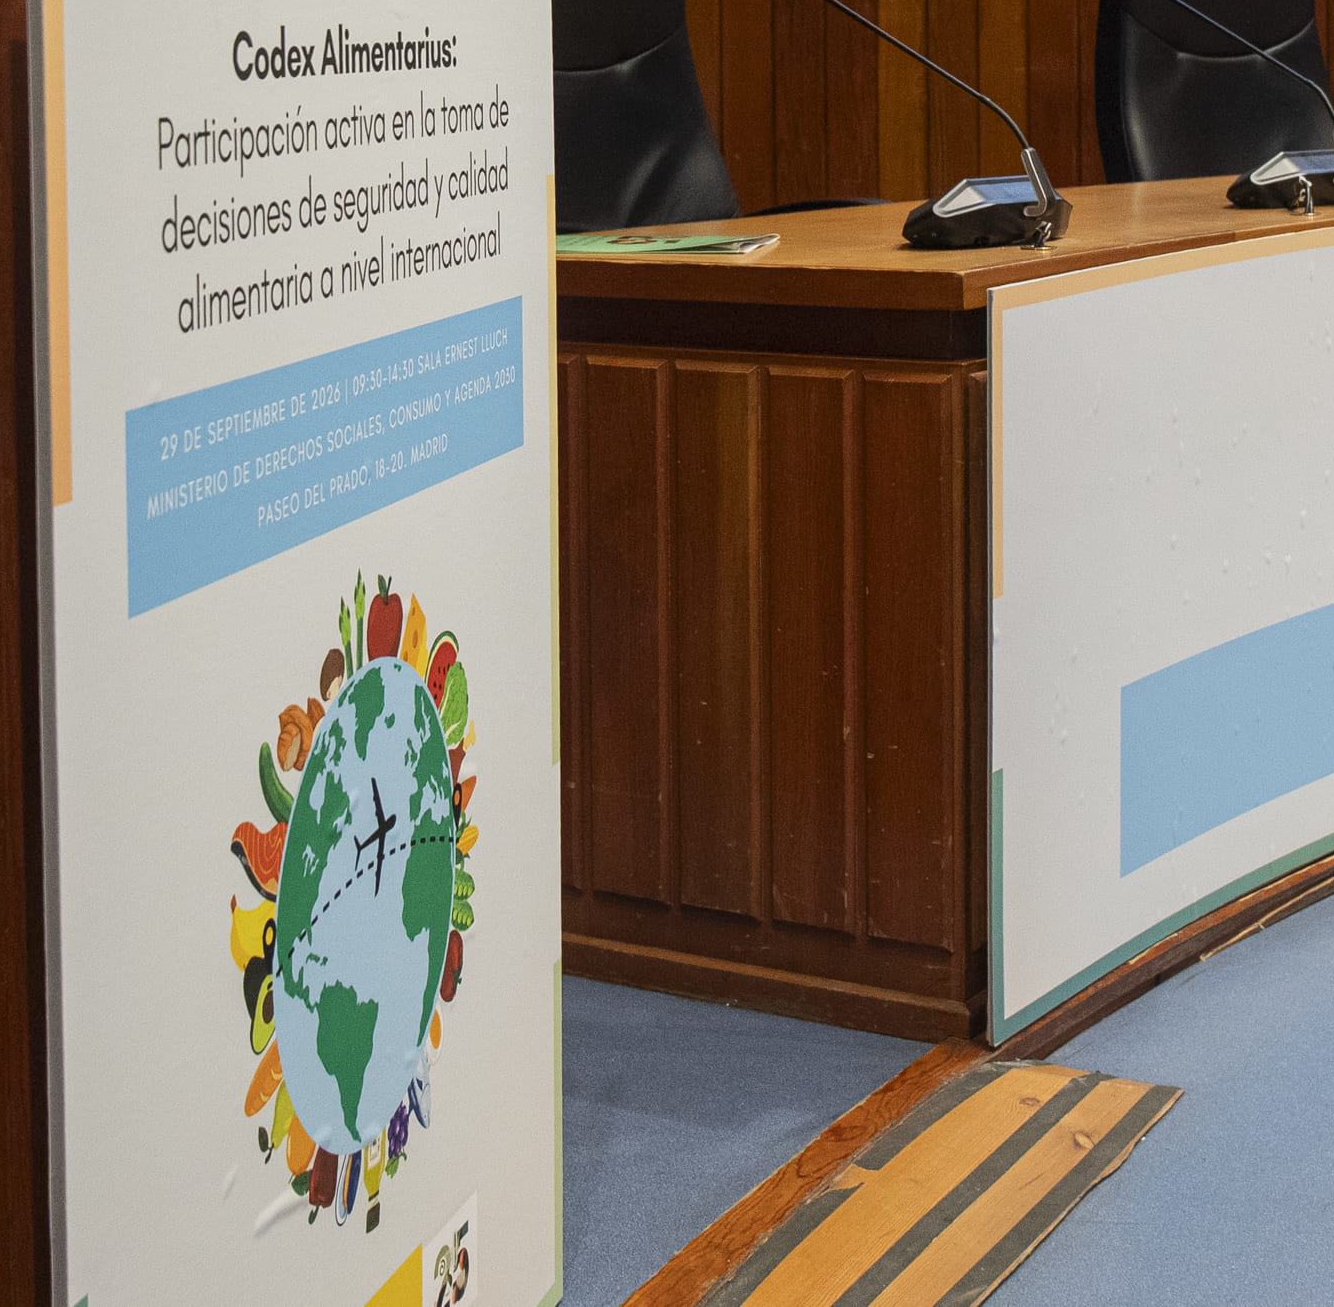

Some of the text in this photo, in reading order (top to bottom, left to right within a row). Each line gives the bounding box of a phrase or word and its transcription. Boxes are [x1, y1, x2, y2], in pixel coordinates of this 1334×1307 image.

[232, 24, 457, 81] Codex Alimentarius:
[158, 84, 509, 177] Participación activa en la toma de
[162, 147, 508, 253] decisiones de seguridad y calidad
[178, 212, 500, 333] alimentaria a nivel internacional
[146, 365, 516, 520] MINISTERIO DE DERECHOS SOCIALES, CONSUMO Y AGENDA 2030
[160, 432, 179, 462] 29
[183, 425, 202, 454] DE
[207, 398, 286, 446] SEPTIEMBRE
[290, 392, 307, 418] DE
[310, 381, 341, 411] 2026
[352, 357, 415, 397] 09:30-14:30
[417, 350, 442, 375] SALA
[444, 336, 479, 366] ERNEST
[480, 328, 508, 354] LLUCH
[257, 432, 449, 528] PASEO DEL PRADO, 18-20. MADRID
